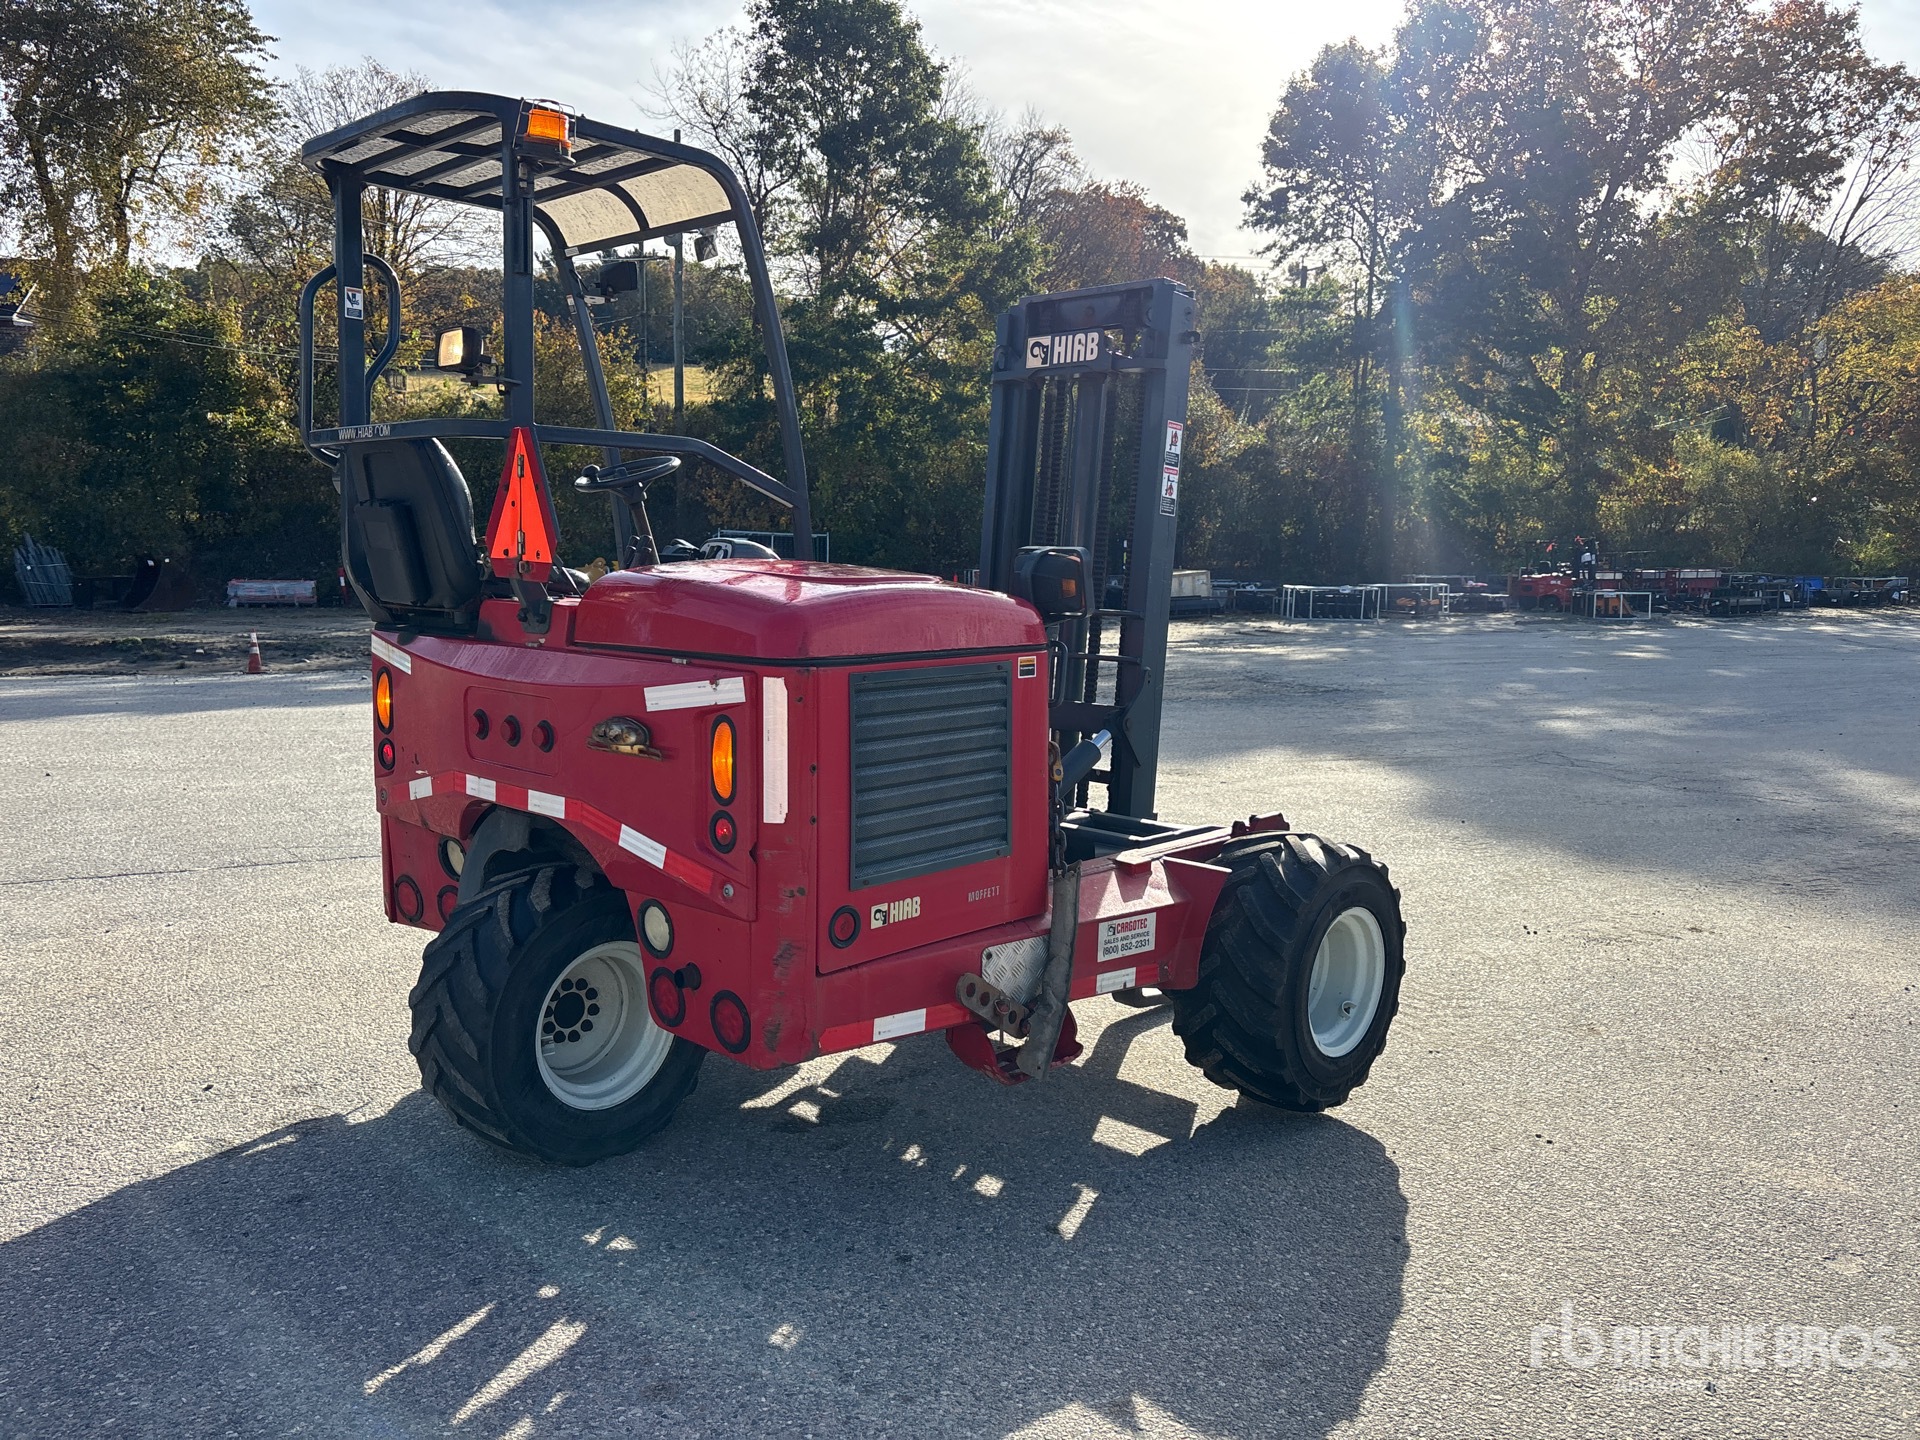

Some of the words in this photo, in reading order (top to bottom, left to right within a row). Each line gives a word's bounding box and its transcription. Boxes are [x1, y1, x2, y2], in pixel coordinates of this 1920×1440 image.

[1053, 332, 1099, 365] HIAB
[338, 425, 391, 440] WWW.HIABCOM
[968, 885, 1000, 903] MOFFETT
[889, 896, 921, 924] HIAB
[1116, 918, 1148, 934] CARGOTEC
[1103, 937, 1119, 945] SALES
[1131, 931, 1150, 940] SERVICE
[1103, 944, 1119, 957] (800)
[1120, 938, 1150, 951] 852-2331
